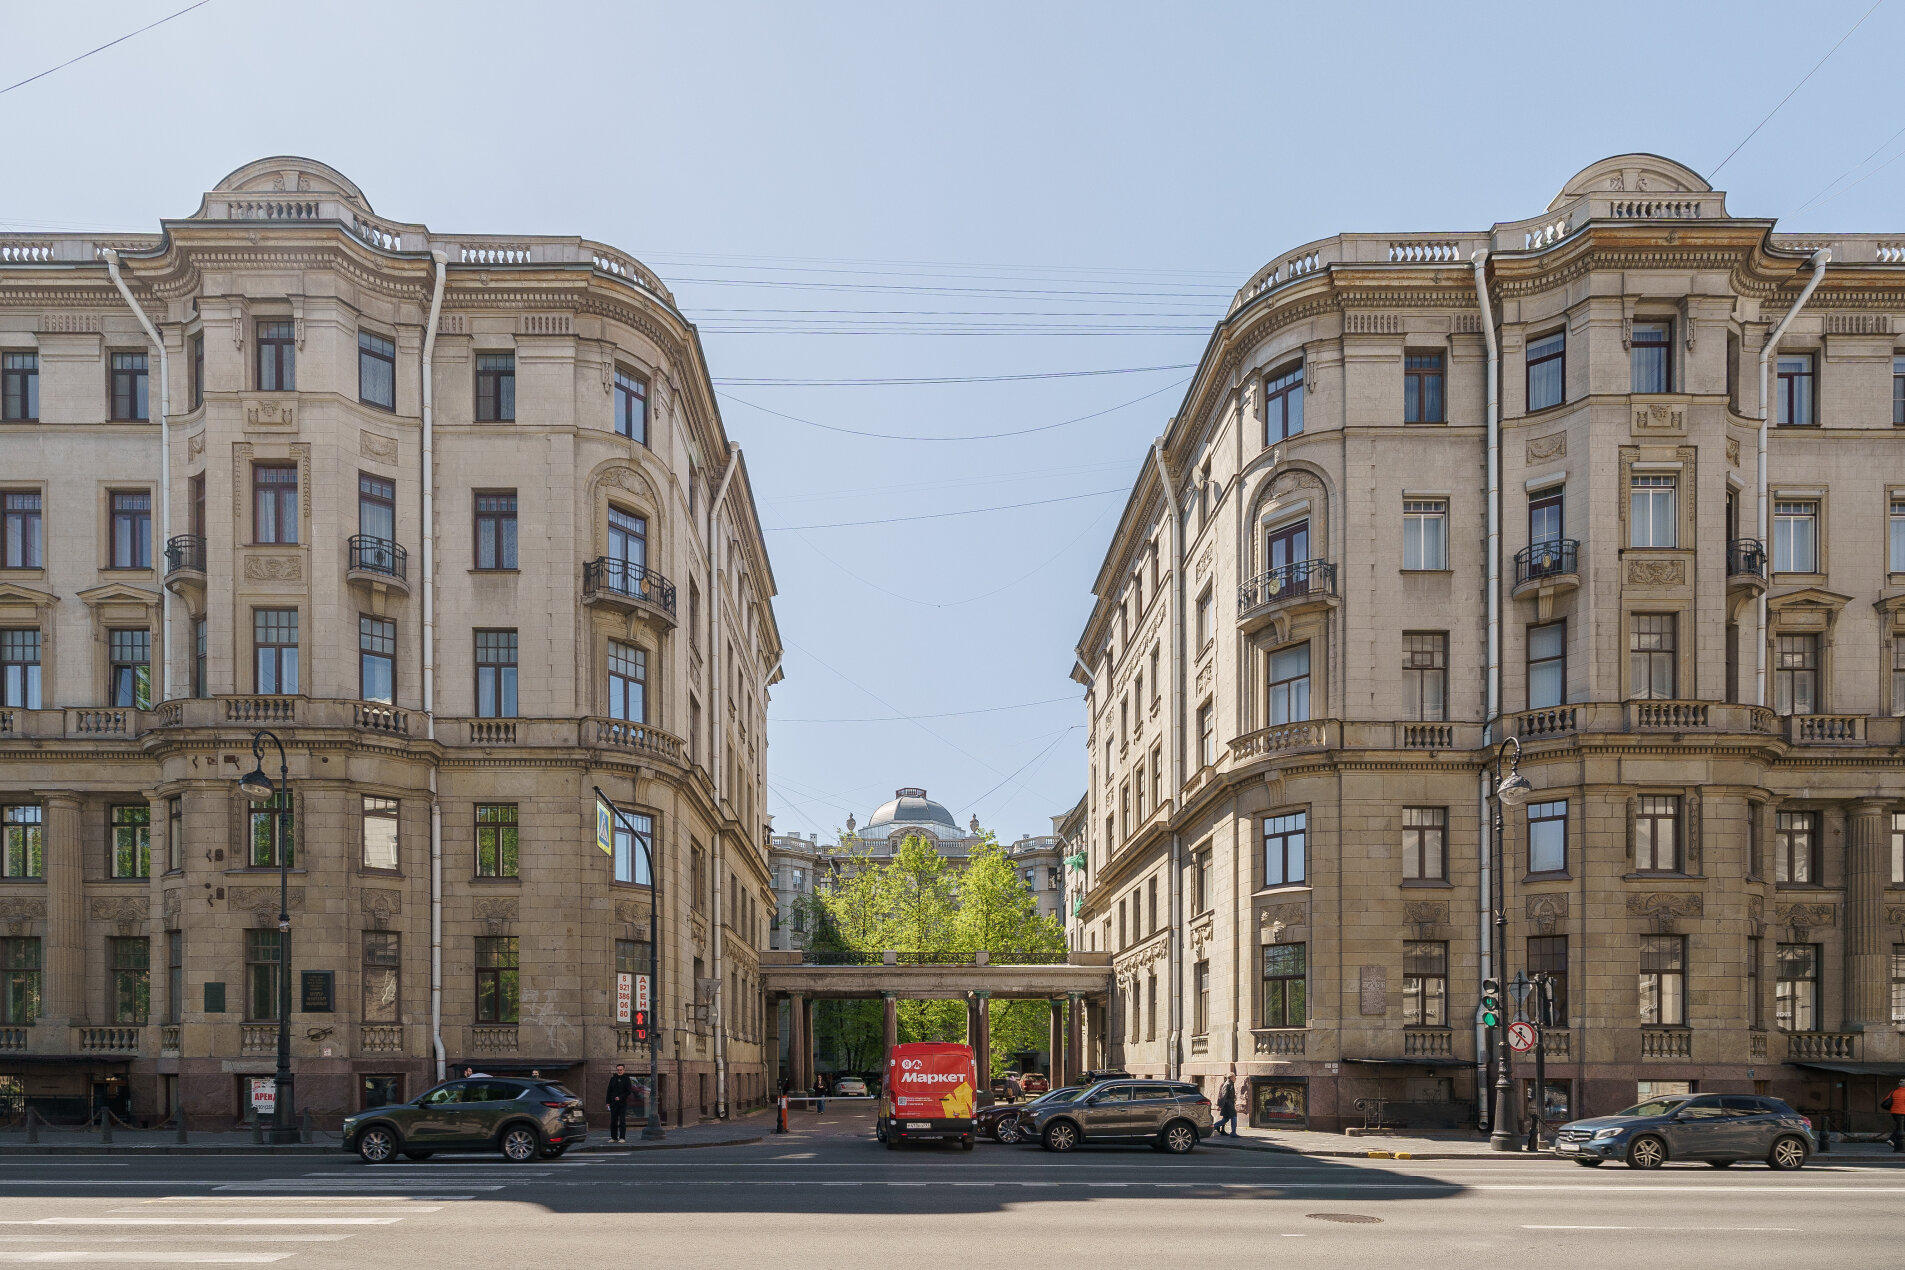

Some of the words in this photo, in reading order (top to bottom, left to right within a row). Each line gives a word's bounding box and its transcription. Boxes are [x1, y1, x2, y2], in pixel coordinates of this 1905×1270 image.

[639, 976, 647, 1011] АРЕН
[620, 1001, 629, 1009] 06
[901, 1072, 966, 1084] Маркет
